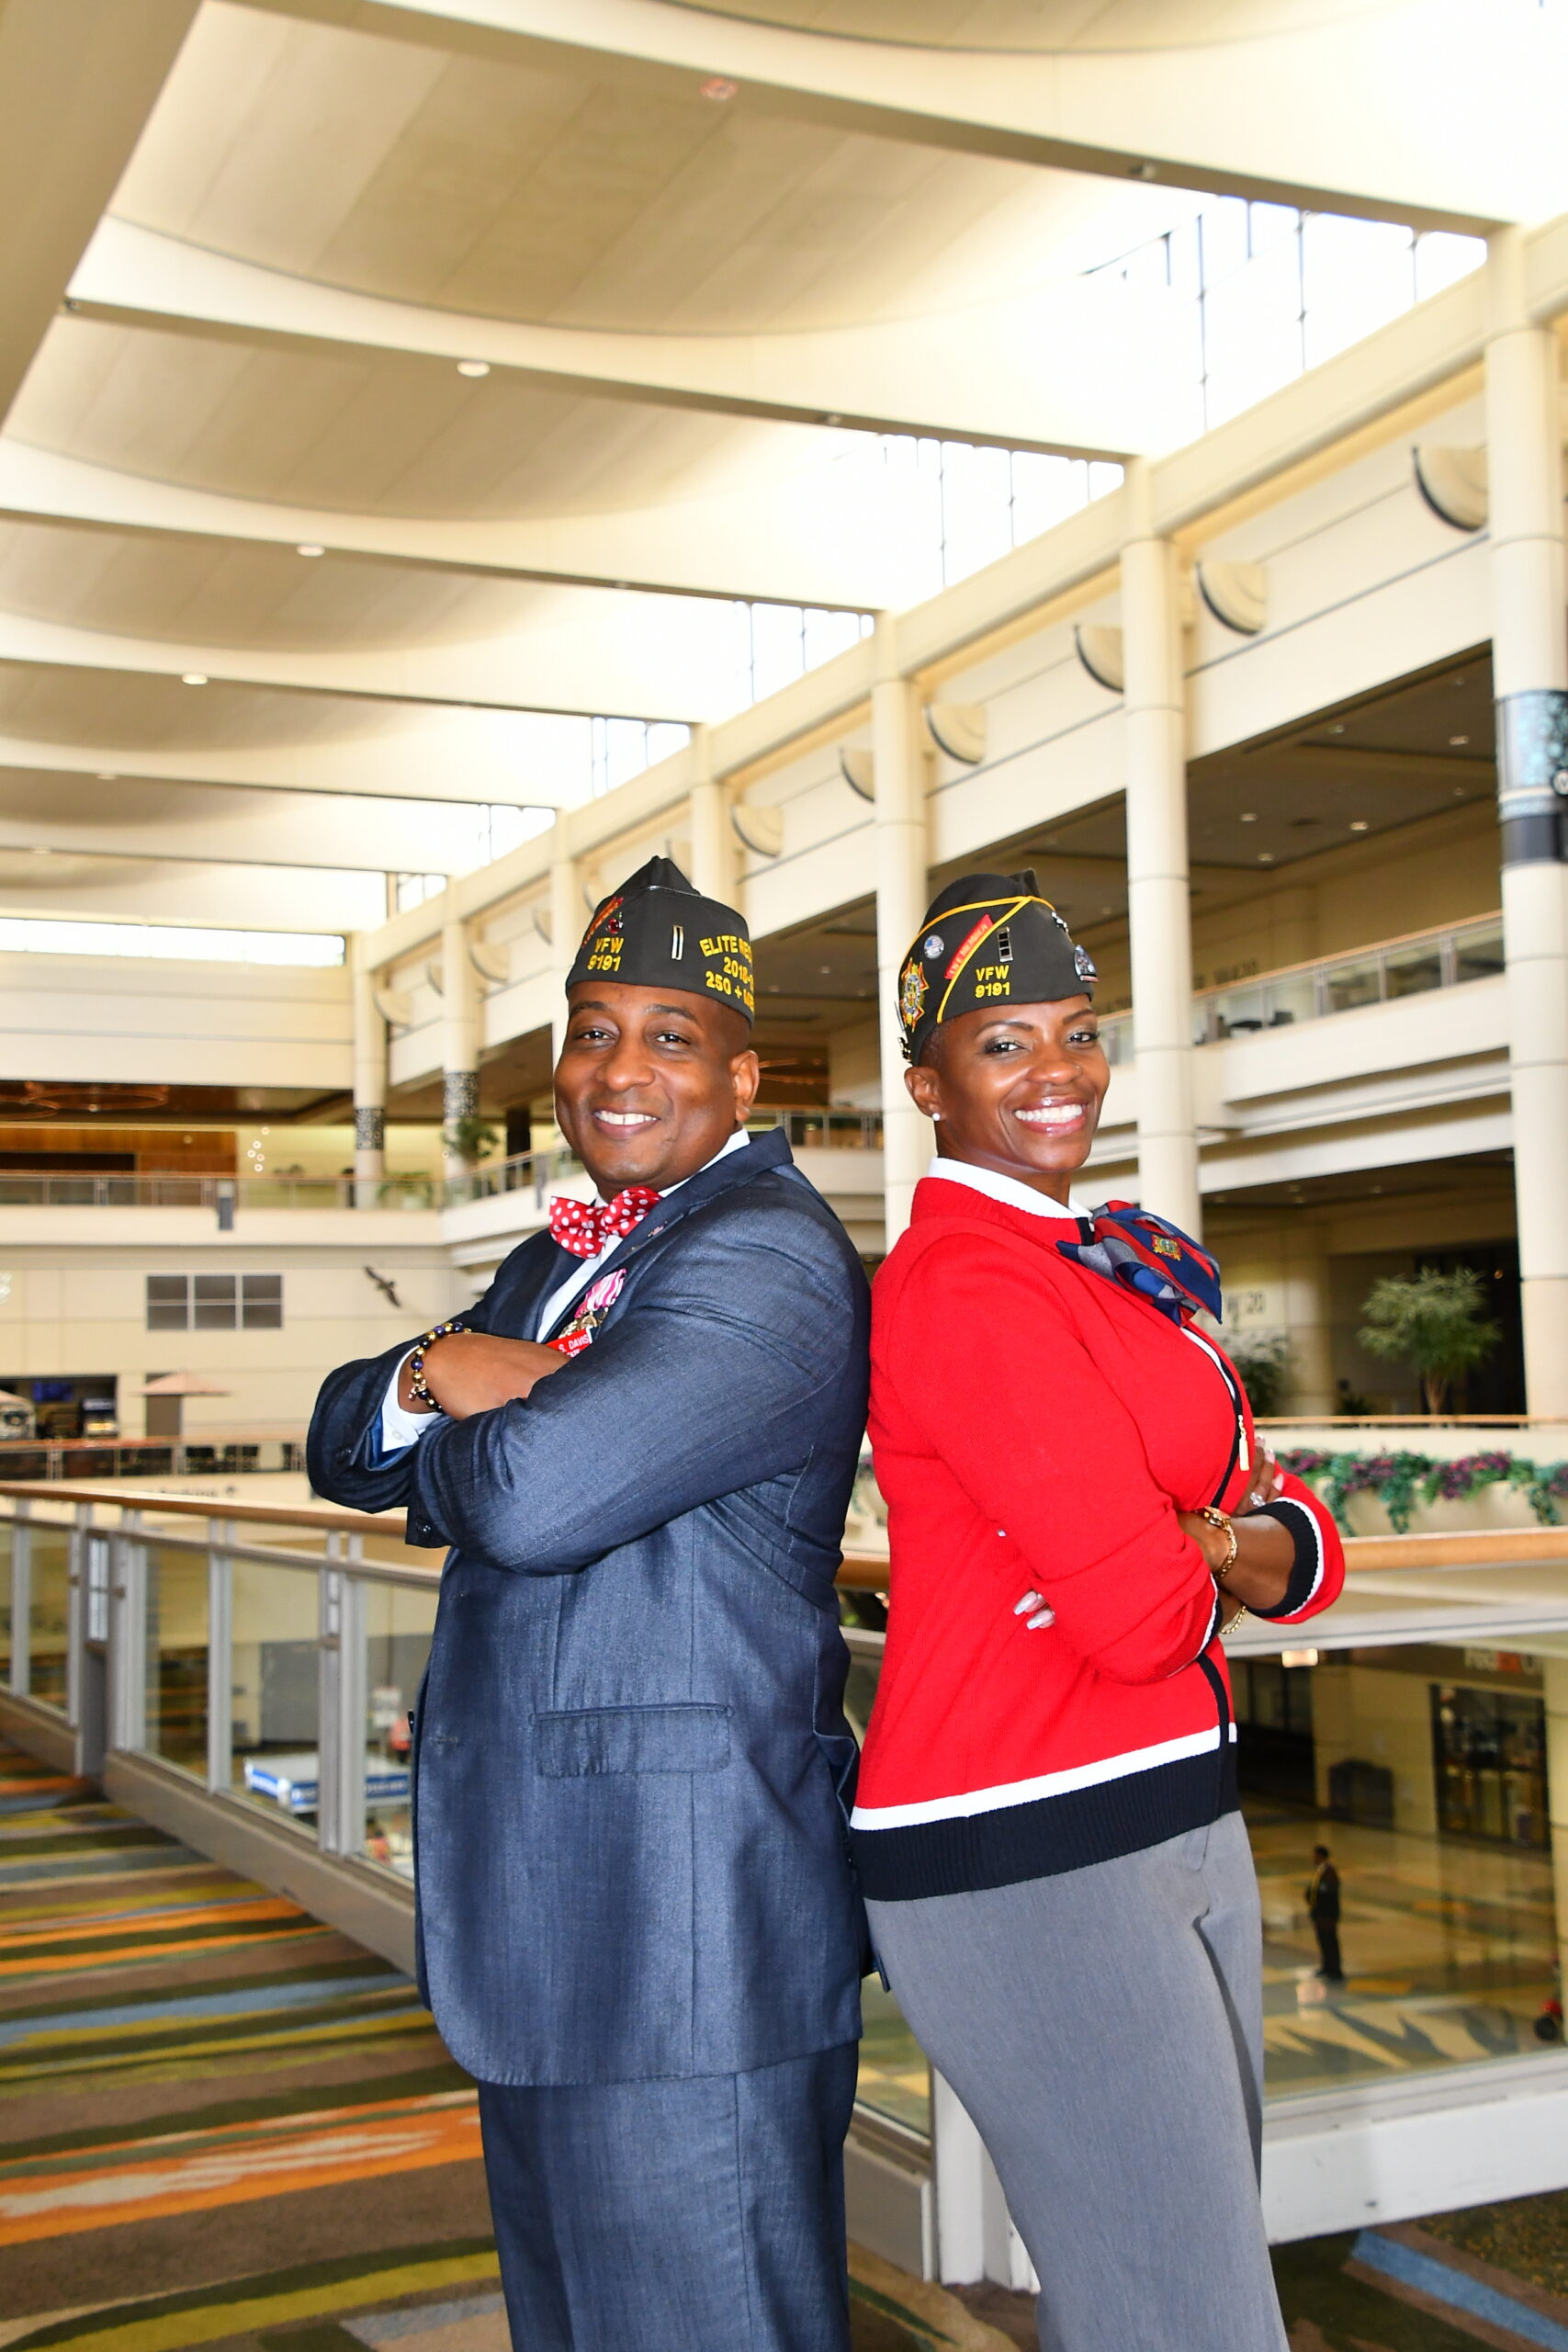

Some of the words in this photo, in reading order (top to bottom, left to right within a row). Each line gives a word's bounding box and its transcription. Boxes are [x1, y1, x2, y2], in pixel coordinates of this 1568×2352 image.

[594, 937, 625, 954] VFW
[699, 934, 739, 956] ELITE
[587, 955, 622, 971] 9191
[976, 965, 1010, 981] VFW
[705, 970, 732, 995] 250
[975, 981, 1010, 999] 9191
[568, 1335, 589, 1350] DAVIS
